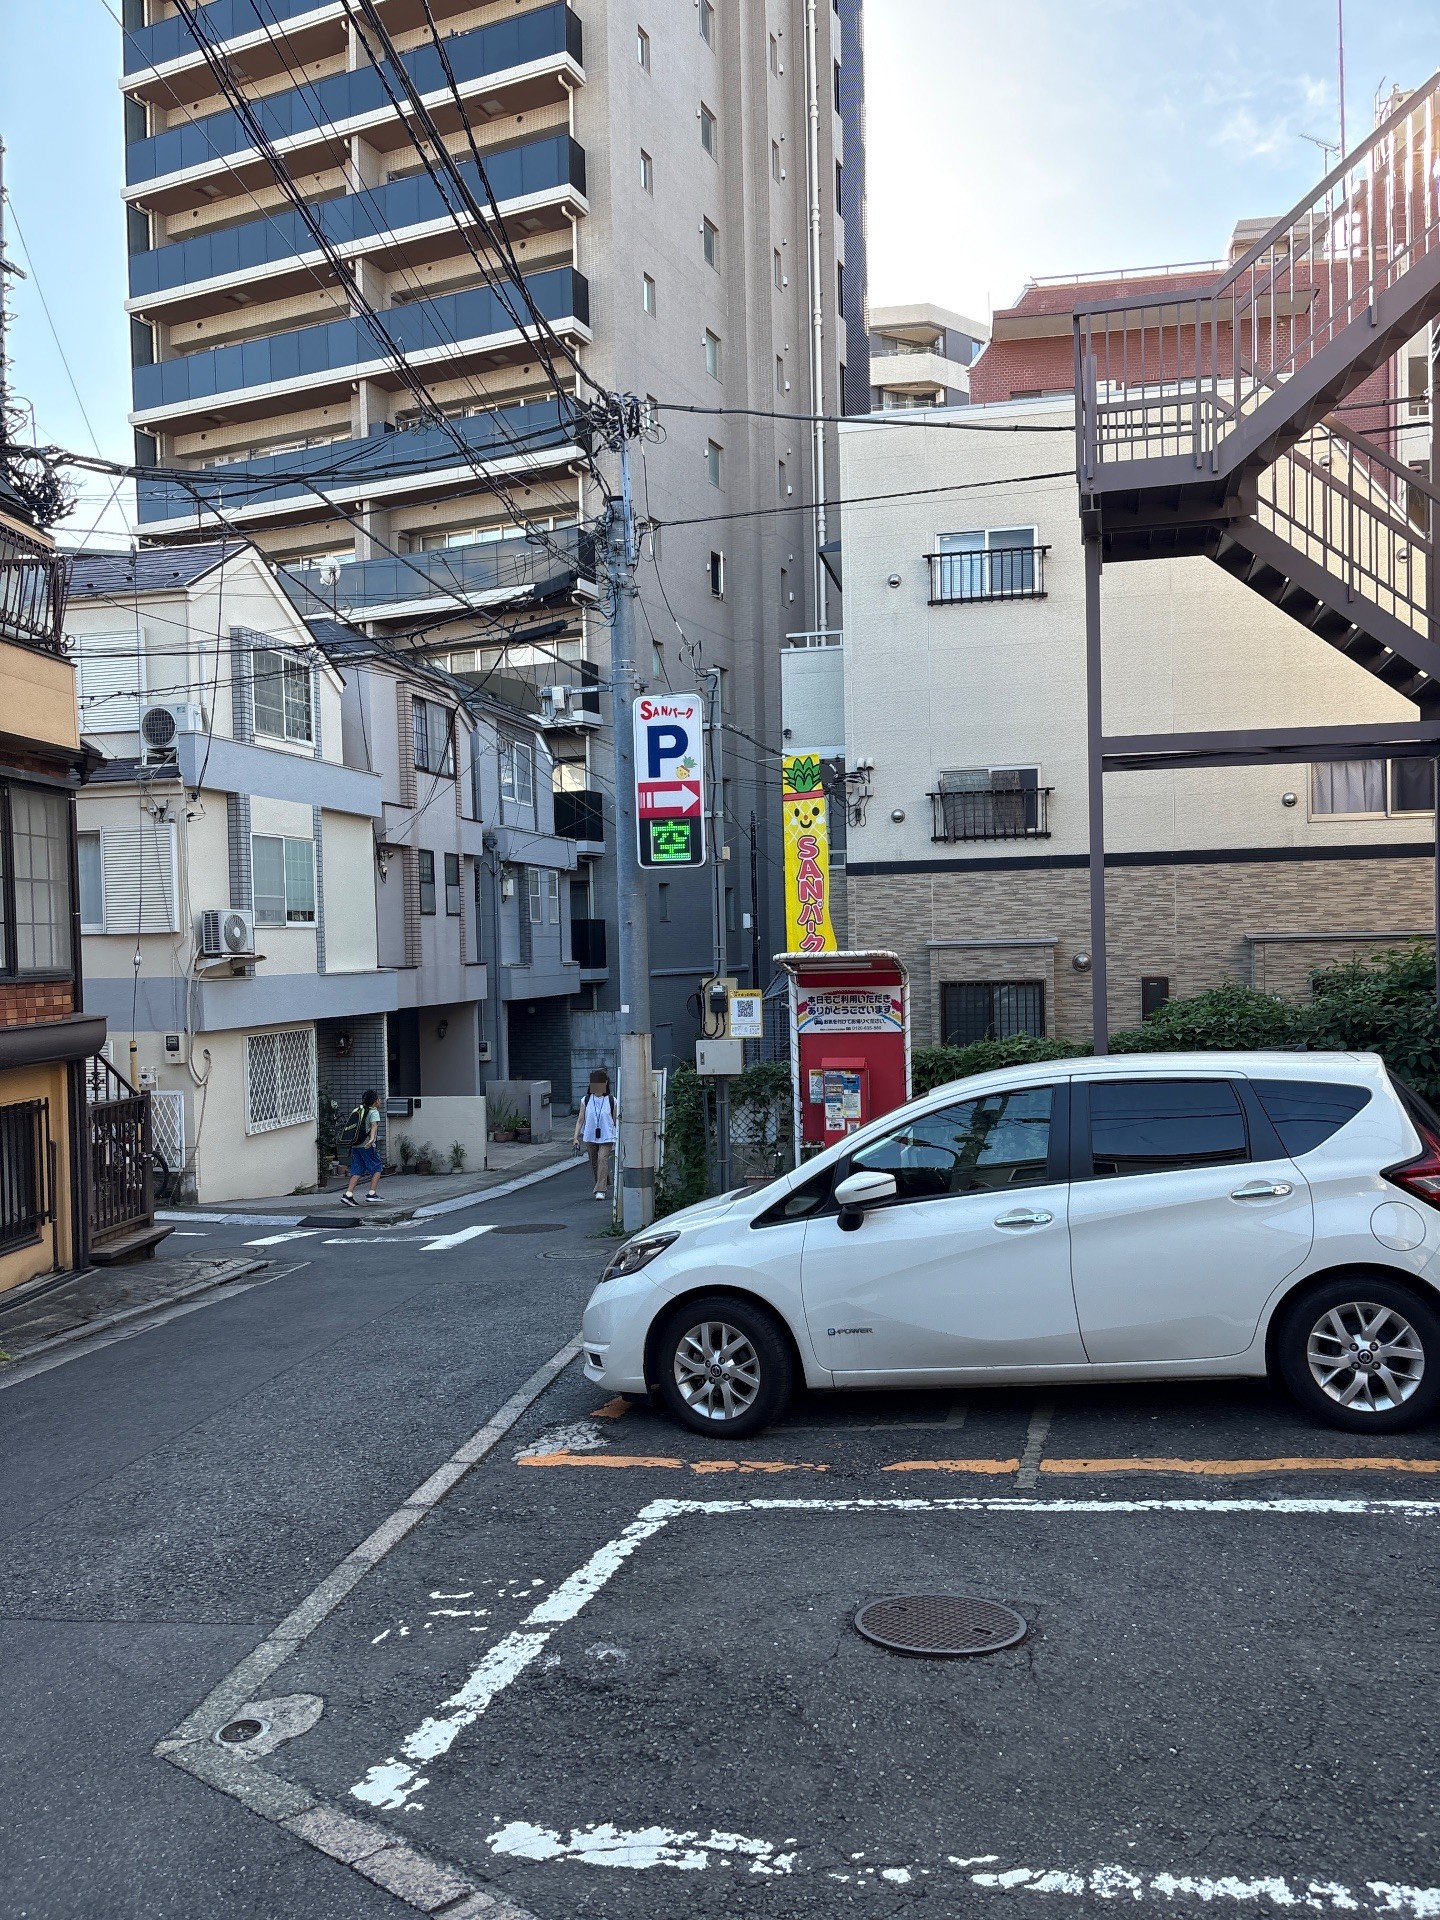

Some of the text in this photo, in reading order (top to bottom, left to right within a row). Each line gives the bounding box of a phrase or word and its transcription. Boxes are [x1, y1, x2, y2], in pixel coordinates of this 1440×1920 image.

[640, 700, 694, 721] SANパーク
[647, 724, 689, 779] P
[652, 821, 691, 860] 空
[807, 994, 892, 1005] 本日もご利用いただき
[807, 1005, 896, 1016] ありがとうございます。
